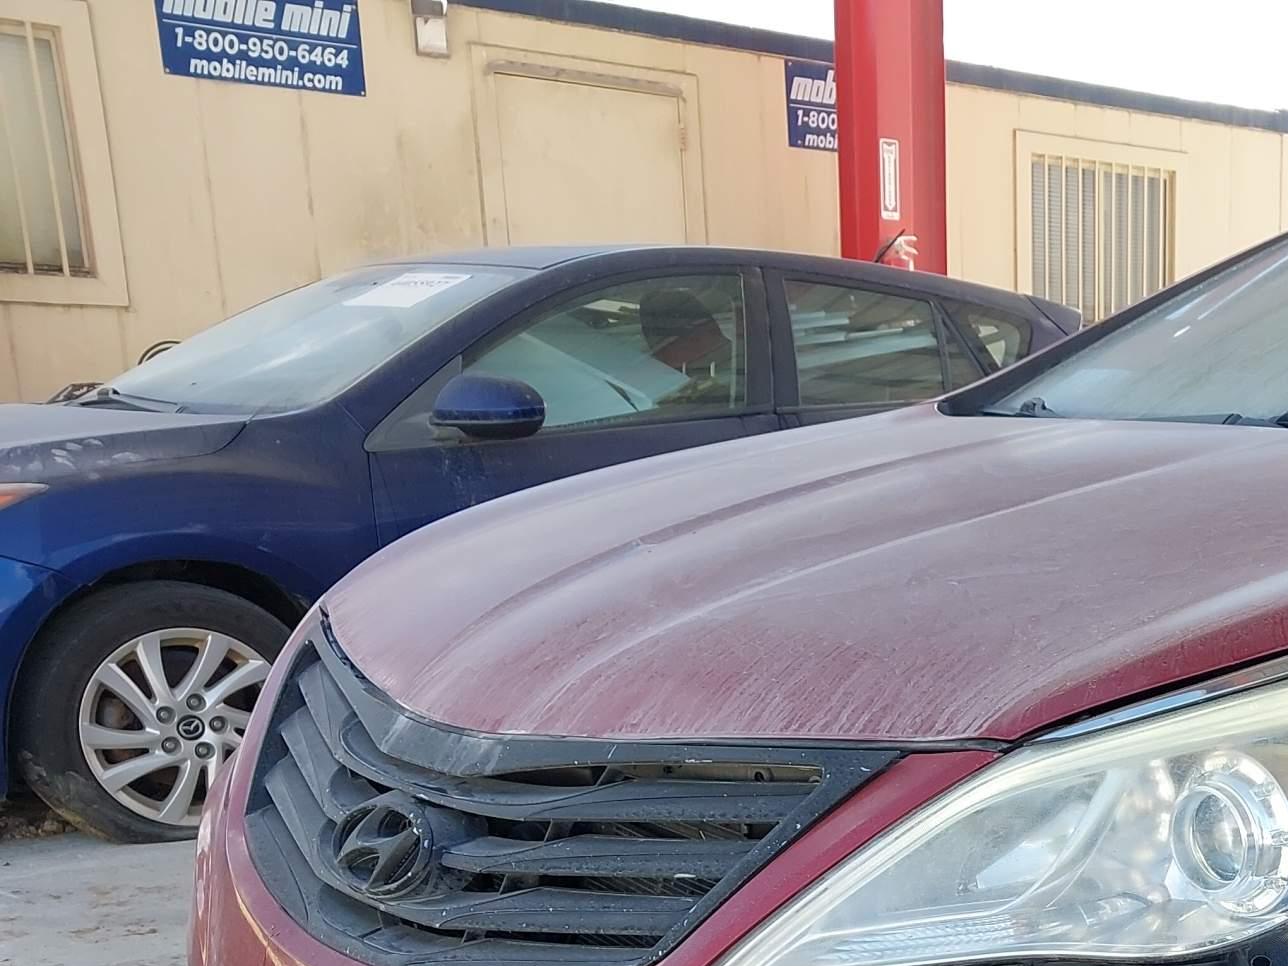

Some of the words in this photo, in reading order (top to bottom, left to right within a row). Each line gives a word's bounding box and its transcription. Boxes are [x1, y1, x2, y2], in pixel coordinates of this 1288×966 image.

[281, 0, 352, 39] mini
[174, 27, 349, 69] 1-800-950-6464
[189, 58, 343, 91] mobilemini.com
